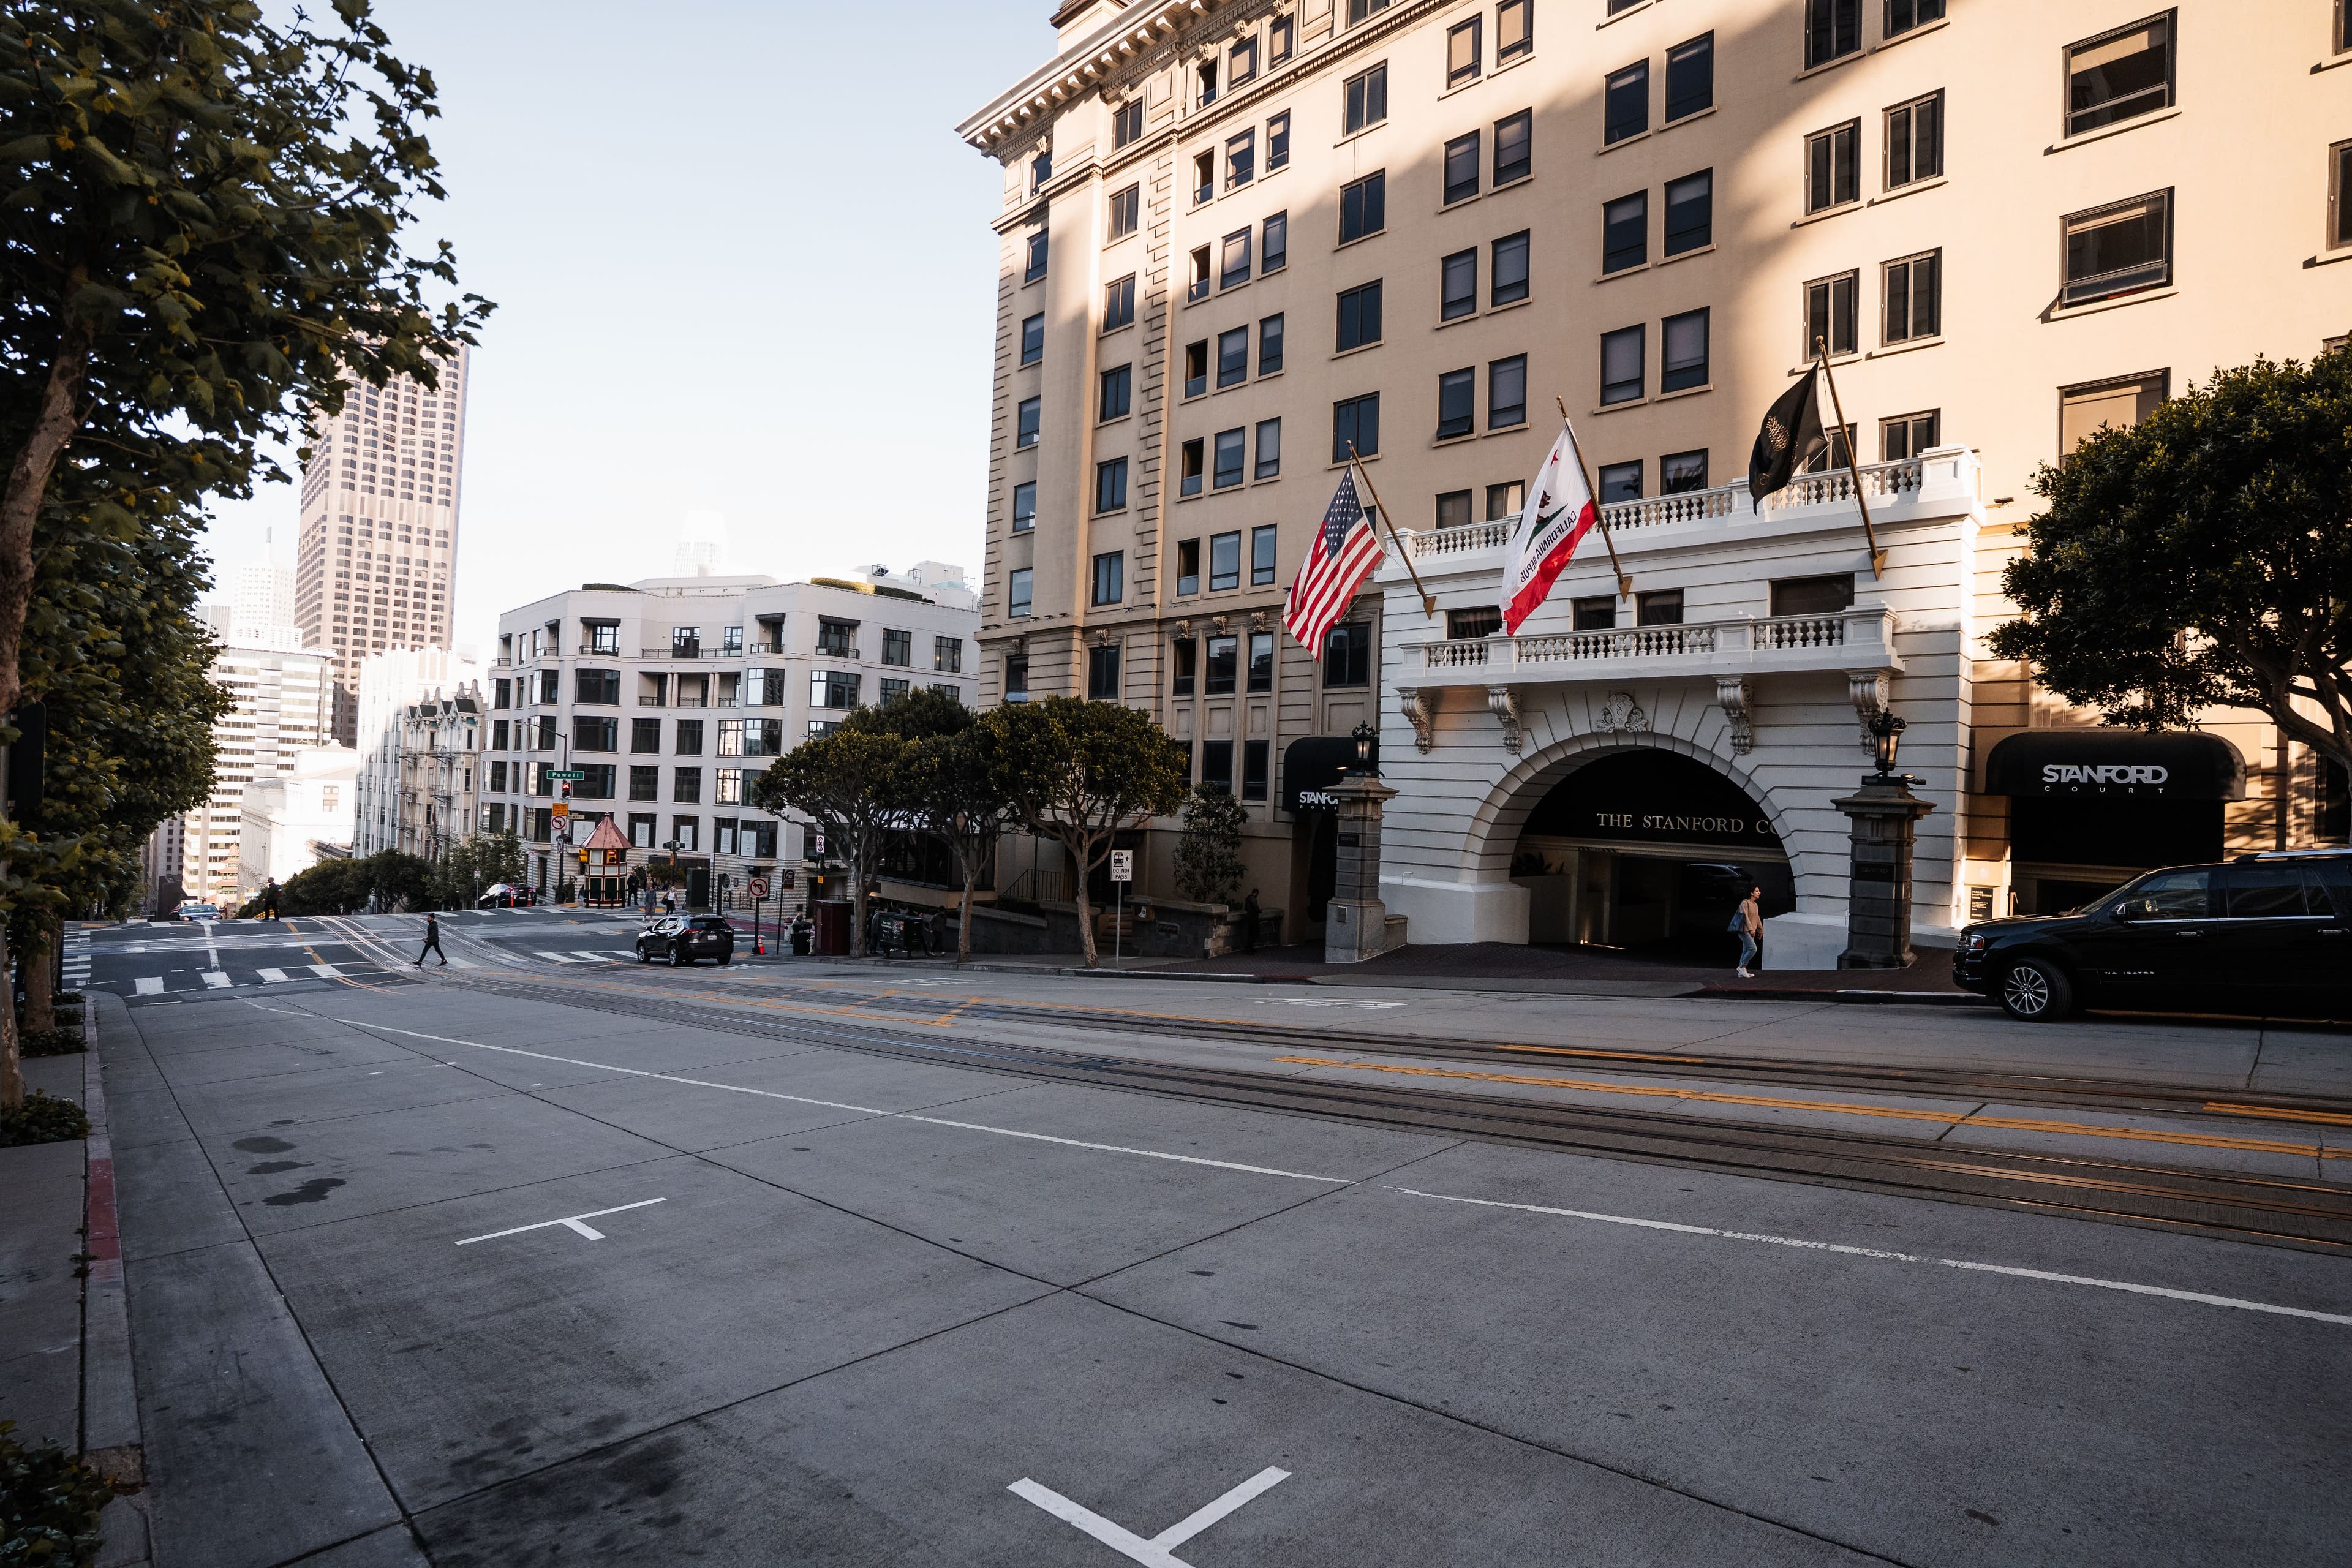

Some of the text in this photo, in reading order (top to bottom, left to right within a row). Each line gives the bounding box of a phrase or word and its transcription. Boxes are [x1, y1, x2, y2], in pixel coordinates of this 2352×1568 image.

[2042, 764, 2168, 784] STANFORD
[1597, 813, 1633, 827] THE
[1643, 816, 1744, 832] STANFORD
